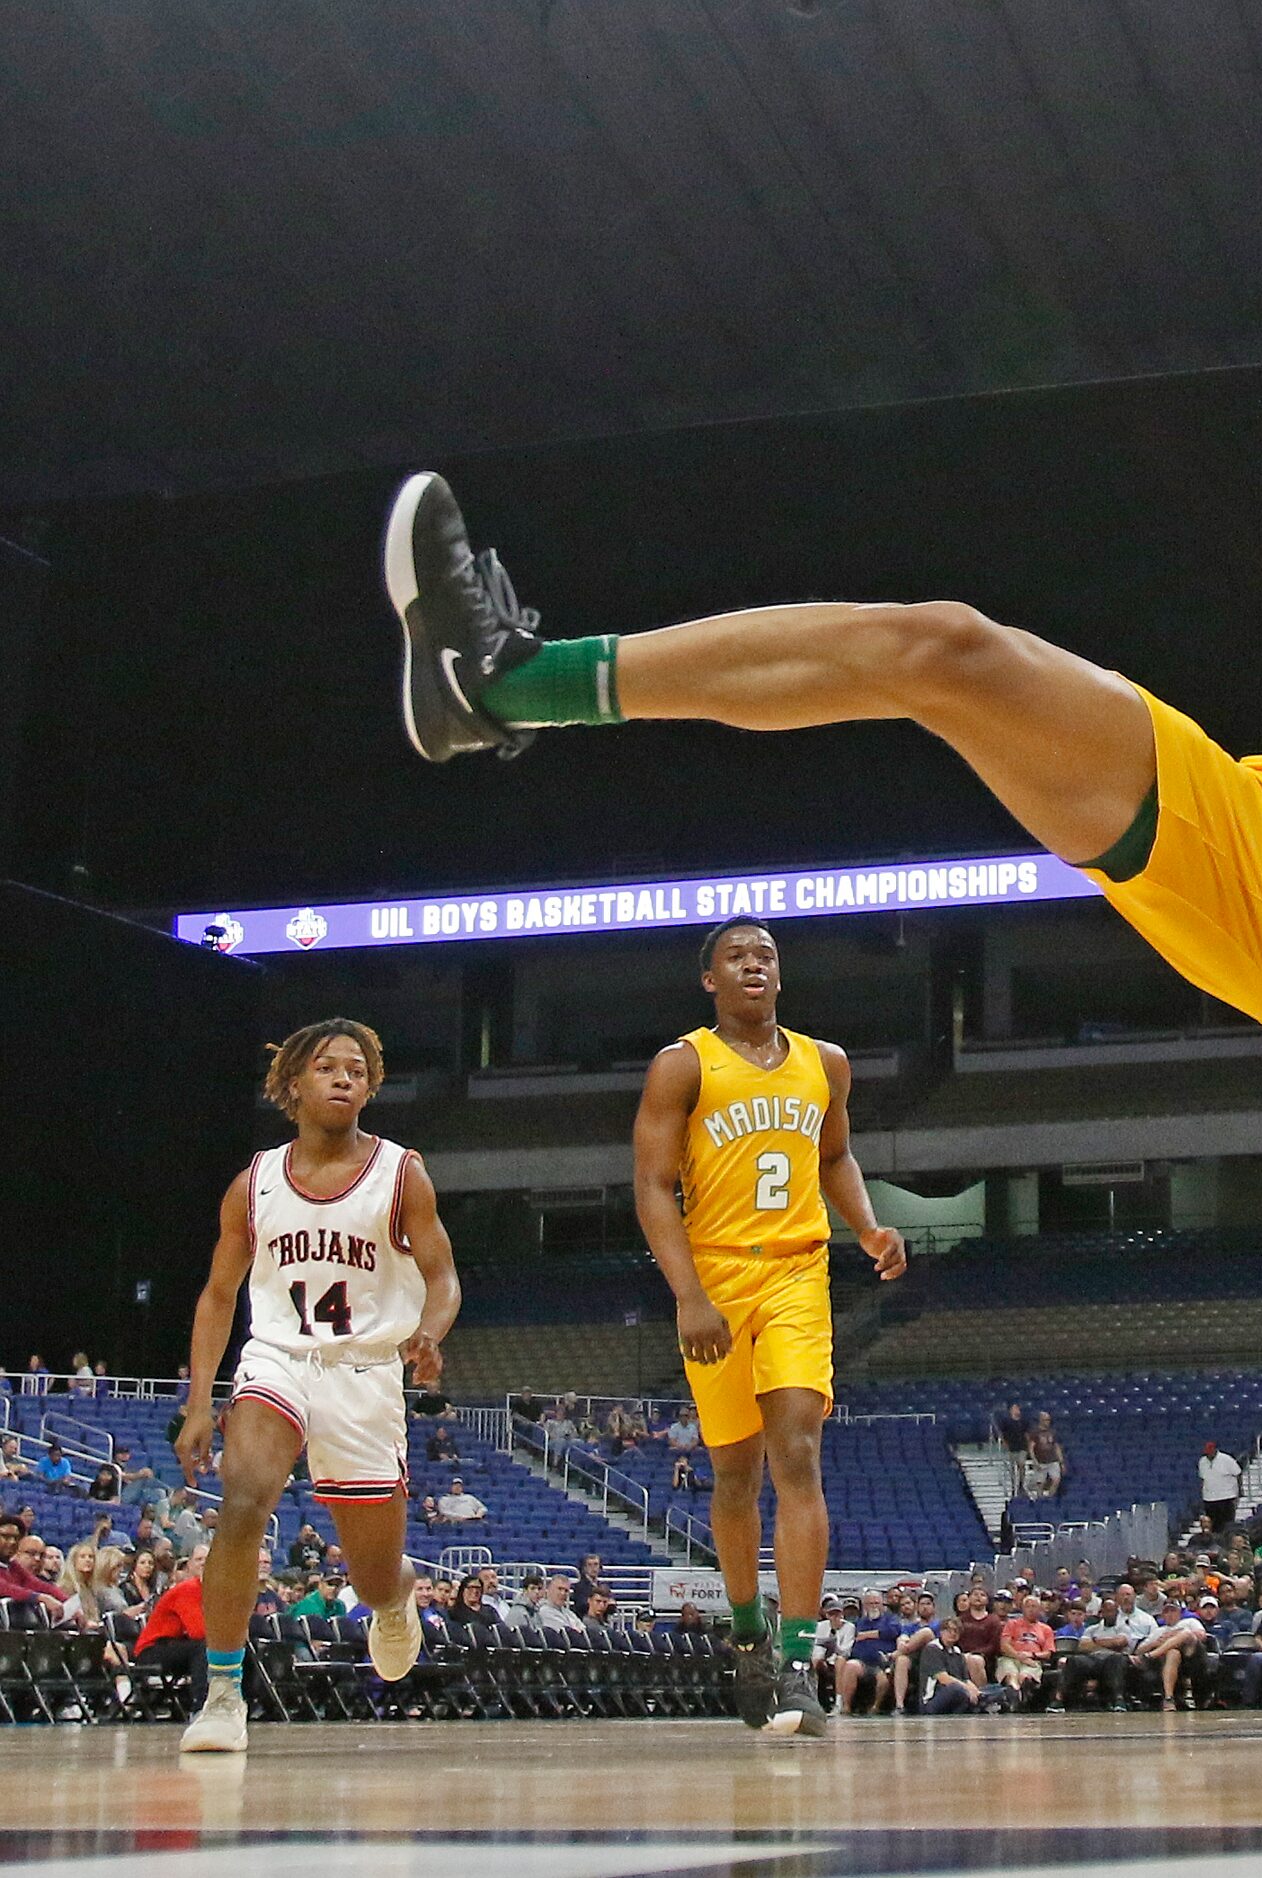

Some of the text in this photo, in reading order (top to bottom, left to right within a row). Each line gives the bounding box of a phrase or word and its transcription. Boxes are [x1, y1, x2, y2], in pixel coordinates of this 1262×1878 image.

[371, 862, 1037, 938] UIL BOYS BASKETBALL STATE CHAMPIONSHIPS
[755, 1151, 790, 1210] 2
[268, 1228, 377, 1272] TROJANS
[289, 1280, 353, 1336] 14
[691, 1589, 722, 1599] FORT
